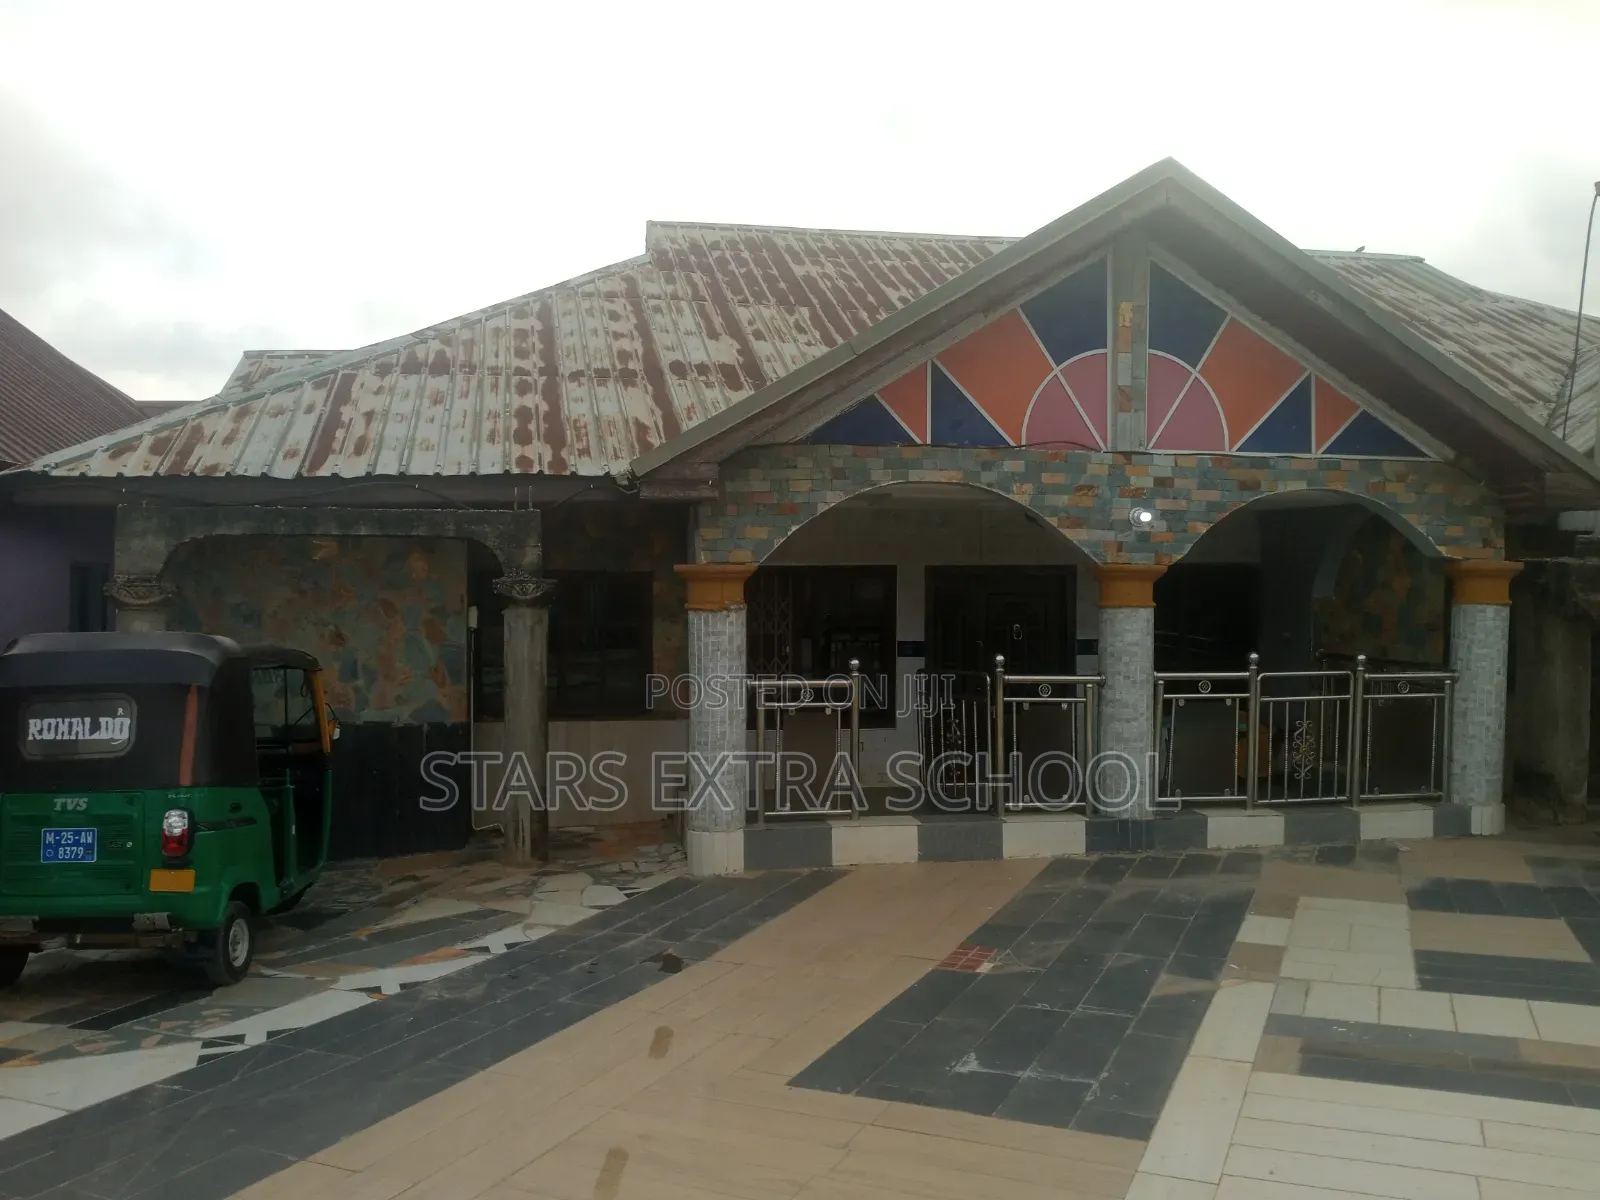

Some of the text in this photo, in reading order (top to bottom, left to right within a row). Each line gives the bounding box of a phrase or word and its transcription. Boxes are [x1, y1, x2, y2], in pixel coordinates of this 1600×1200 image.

[28, 717, 131, 740] RONALDO
[53, 797, 89, 811] TVS
[45, 831, 93, 844] M-25-AW
[58, 846, 84, 859] 8379
